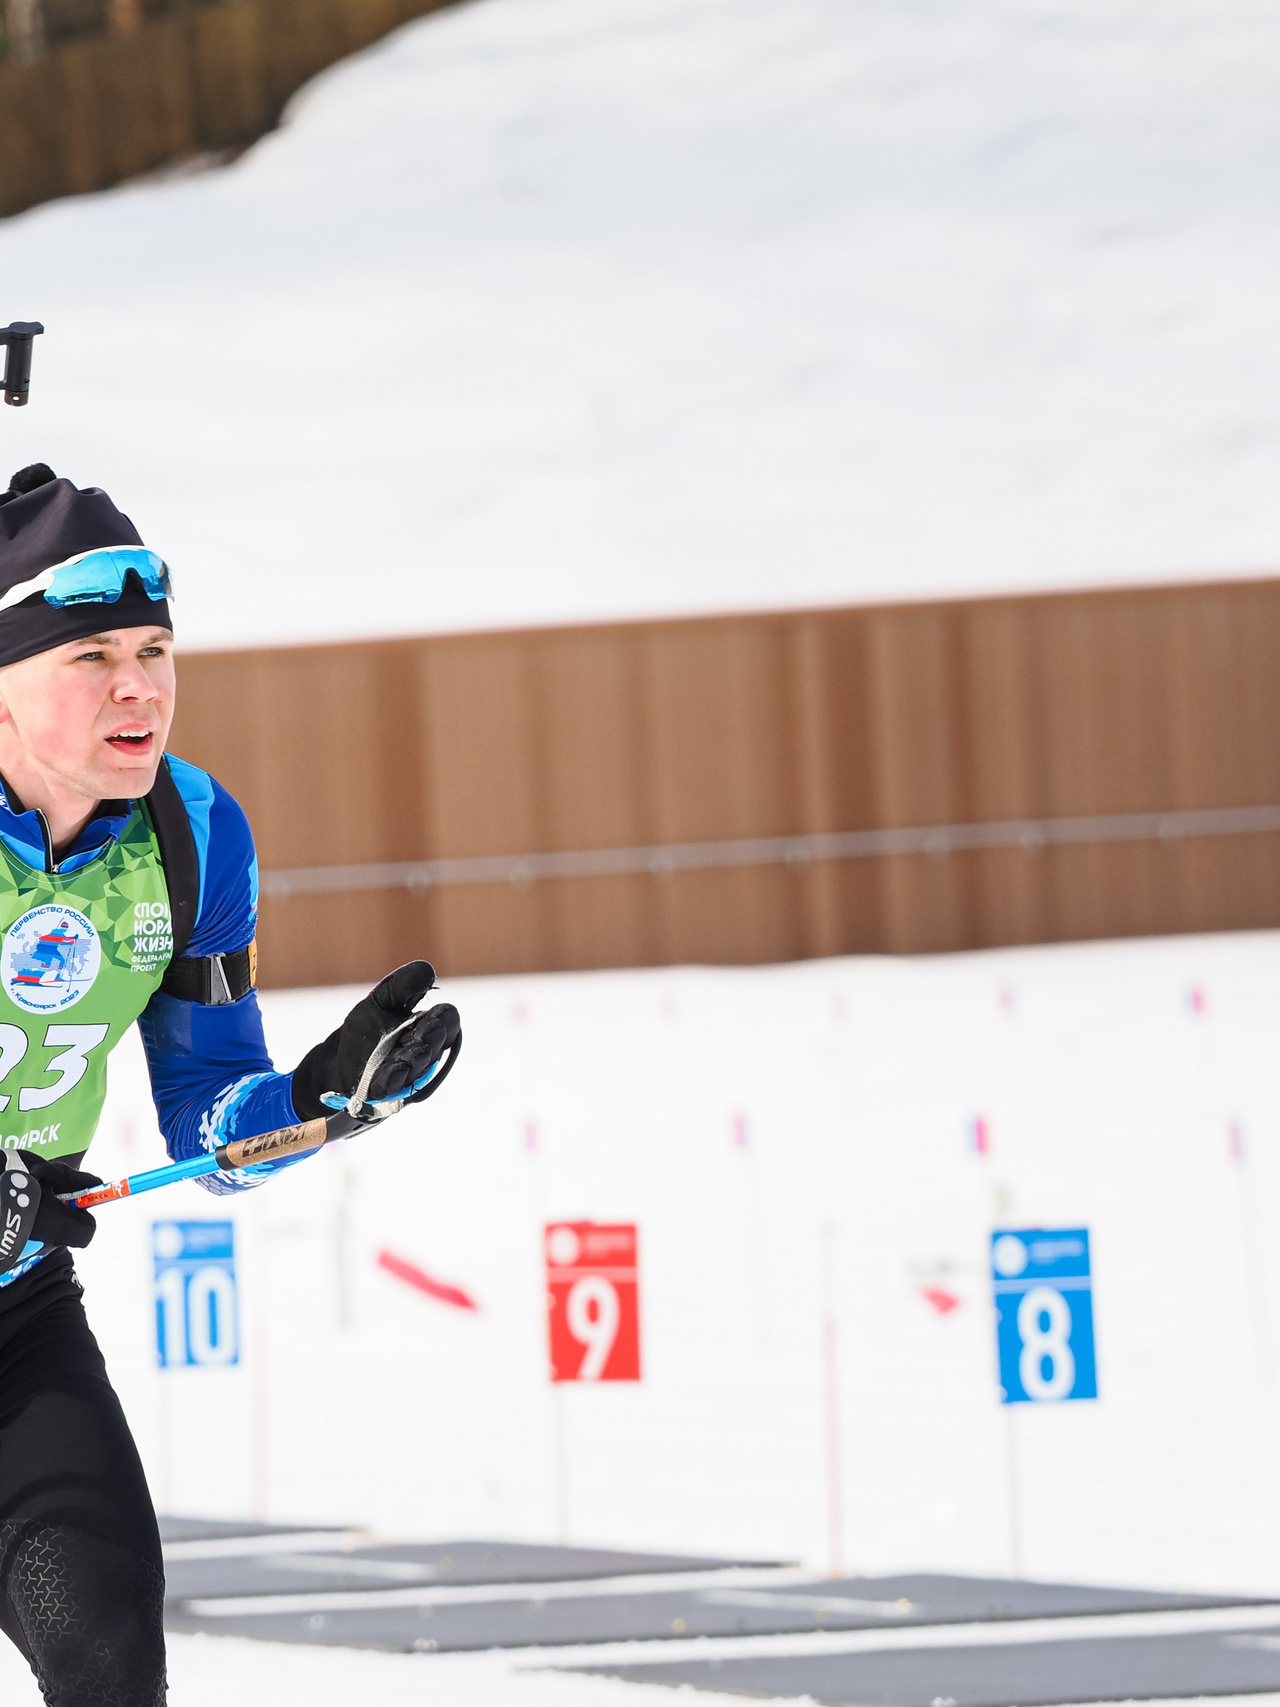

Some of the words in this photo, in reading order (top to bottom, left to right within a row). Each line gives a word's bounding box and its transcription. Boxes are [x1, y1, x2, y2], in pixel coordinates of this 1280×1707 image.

[10, 906, 64, 938] ПЕРВЕНСТВО
[64, 908, 95, 938] РОССИИ
[132, 935, 174, 953] ЖИЗН
[130, 963, 157, 973] ПРОЕКТ
[15, 992, 57, 1011] Красноярск
[60, 989, 81, 1006] 2023
[155, 1266, 239, 1367] 10
[565, 1275, 620, 1381] 9
[1017, 1286, 1076, 1402] 8
